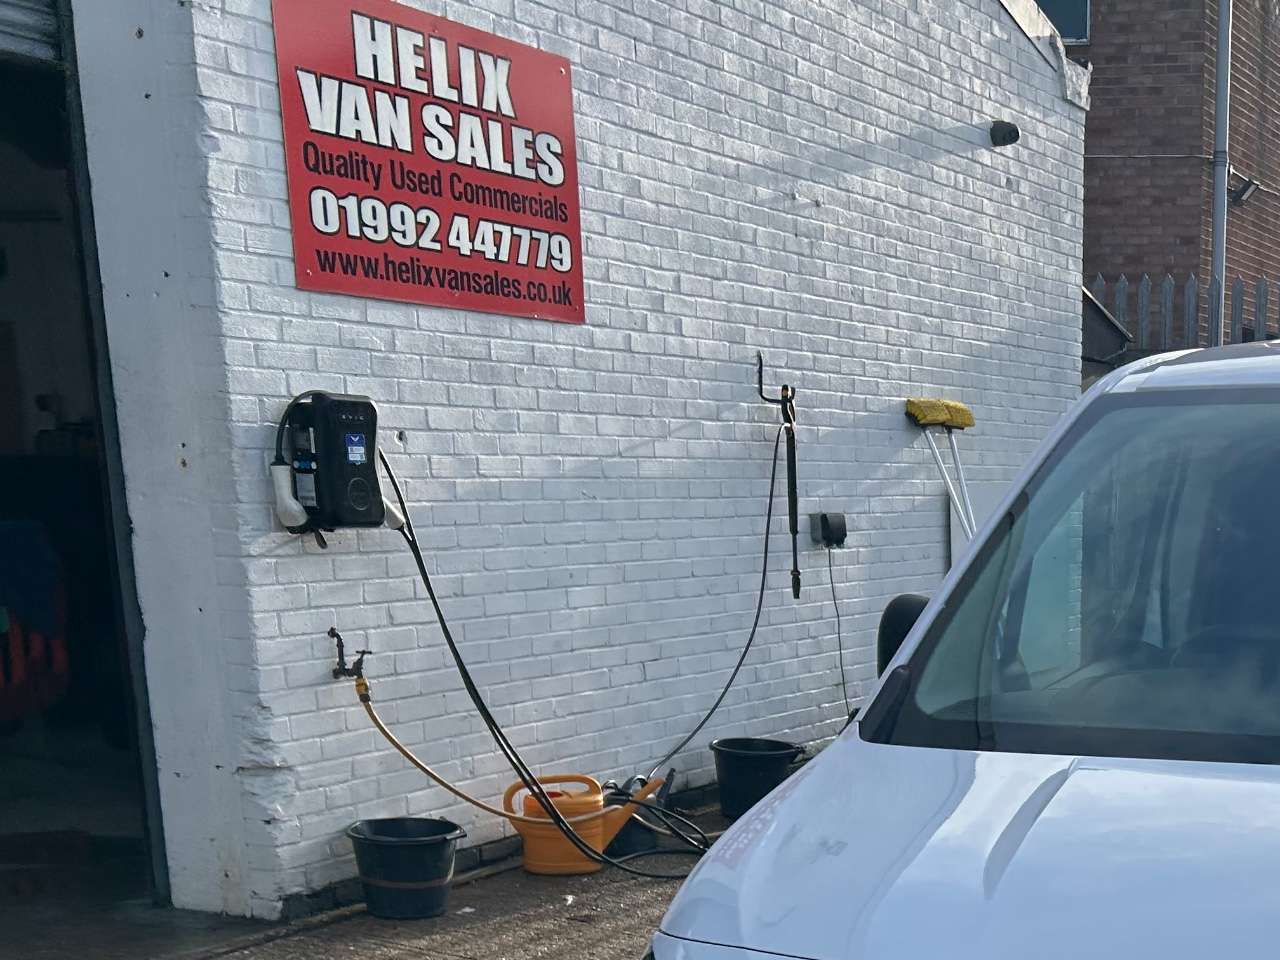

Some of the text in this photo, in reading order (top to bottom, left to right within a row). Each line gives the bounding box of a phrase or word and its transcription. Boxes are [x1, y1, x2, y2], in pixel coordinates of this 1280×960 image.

[351, 10, 516, 119] HELIX
[296, 66, 565, 186] VAN SALES
[303, 141, 568, 223] Quality Used Commercials
[309, 187, 573, 273] 01992 447779
[315, 249, 572, 306] www.helixvansales.co.uk
